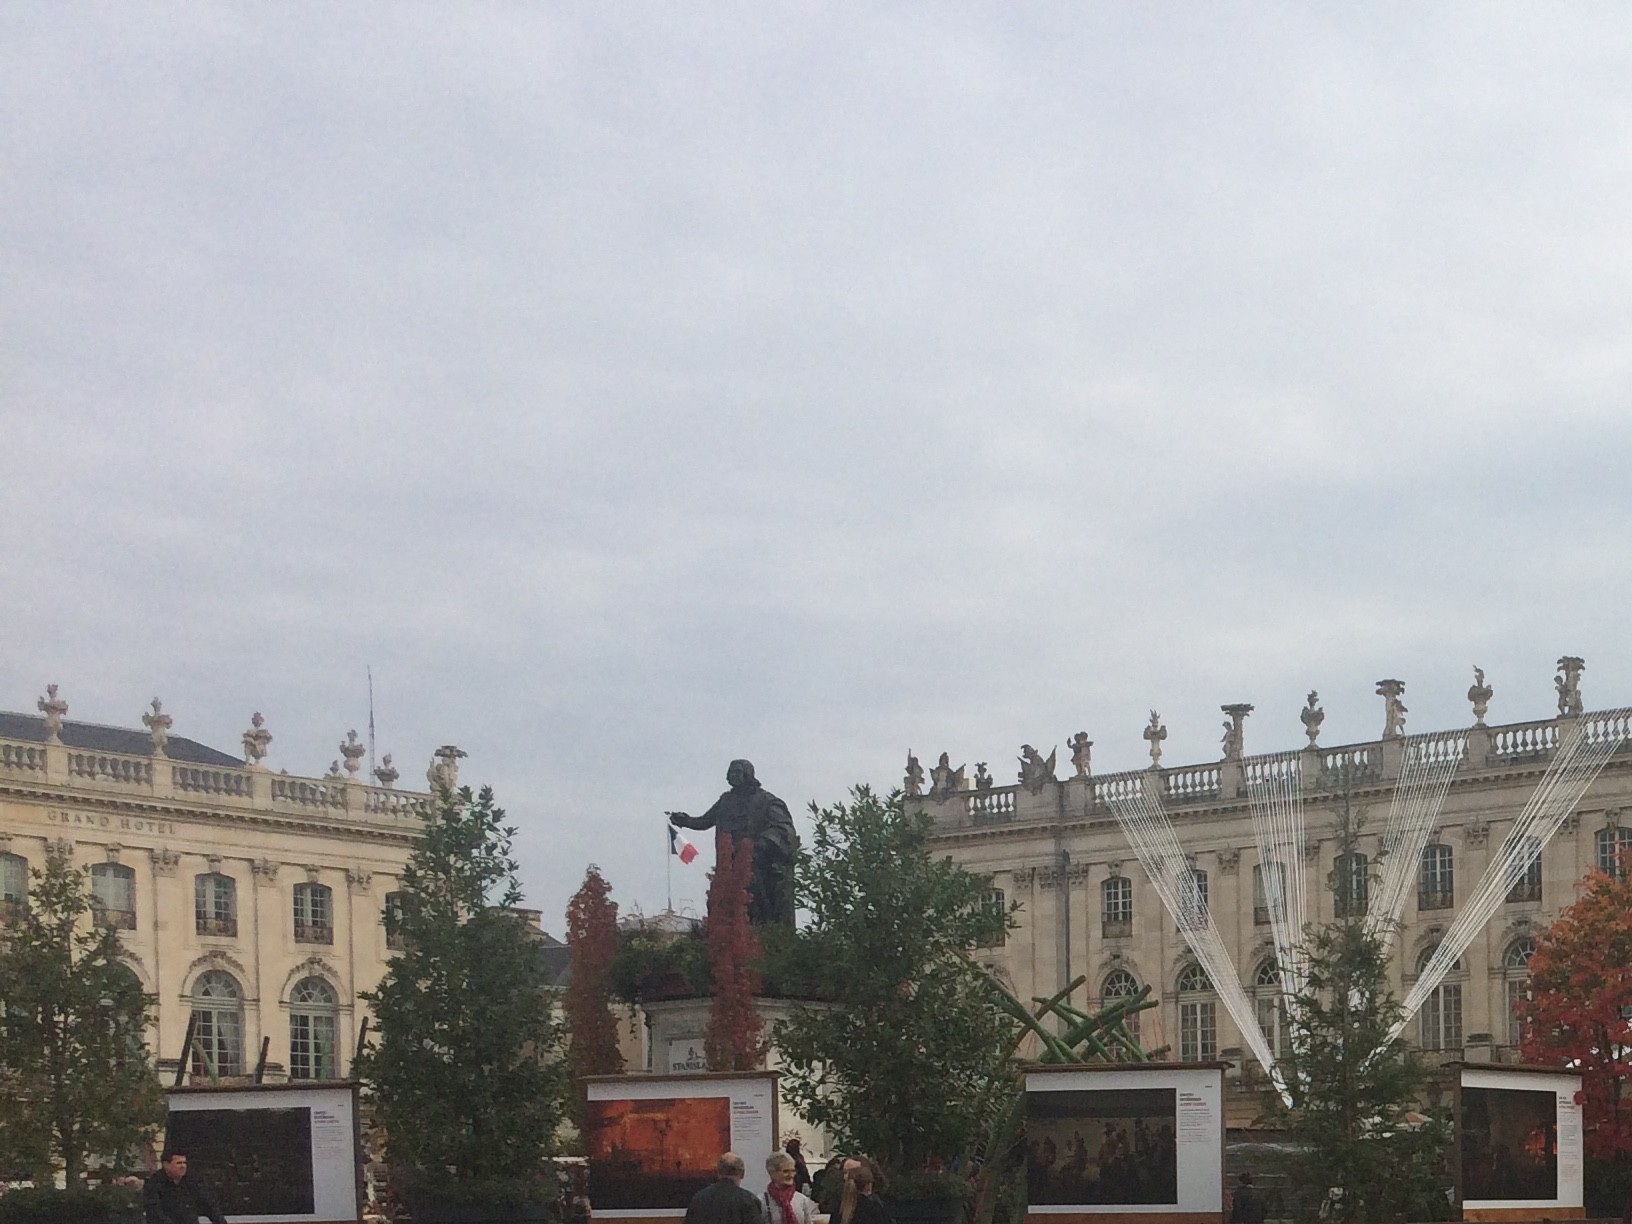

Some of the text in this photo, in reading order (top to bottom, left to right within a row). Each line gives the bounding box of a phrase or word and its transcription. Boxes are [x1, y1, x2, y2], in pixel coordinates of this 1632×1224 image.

[47, 810, 175, 835] GRAND HOTEL
[672, 1061, 706, 1071] STANISLA
